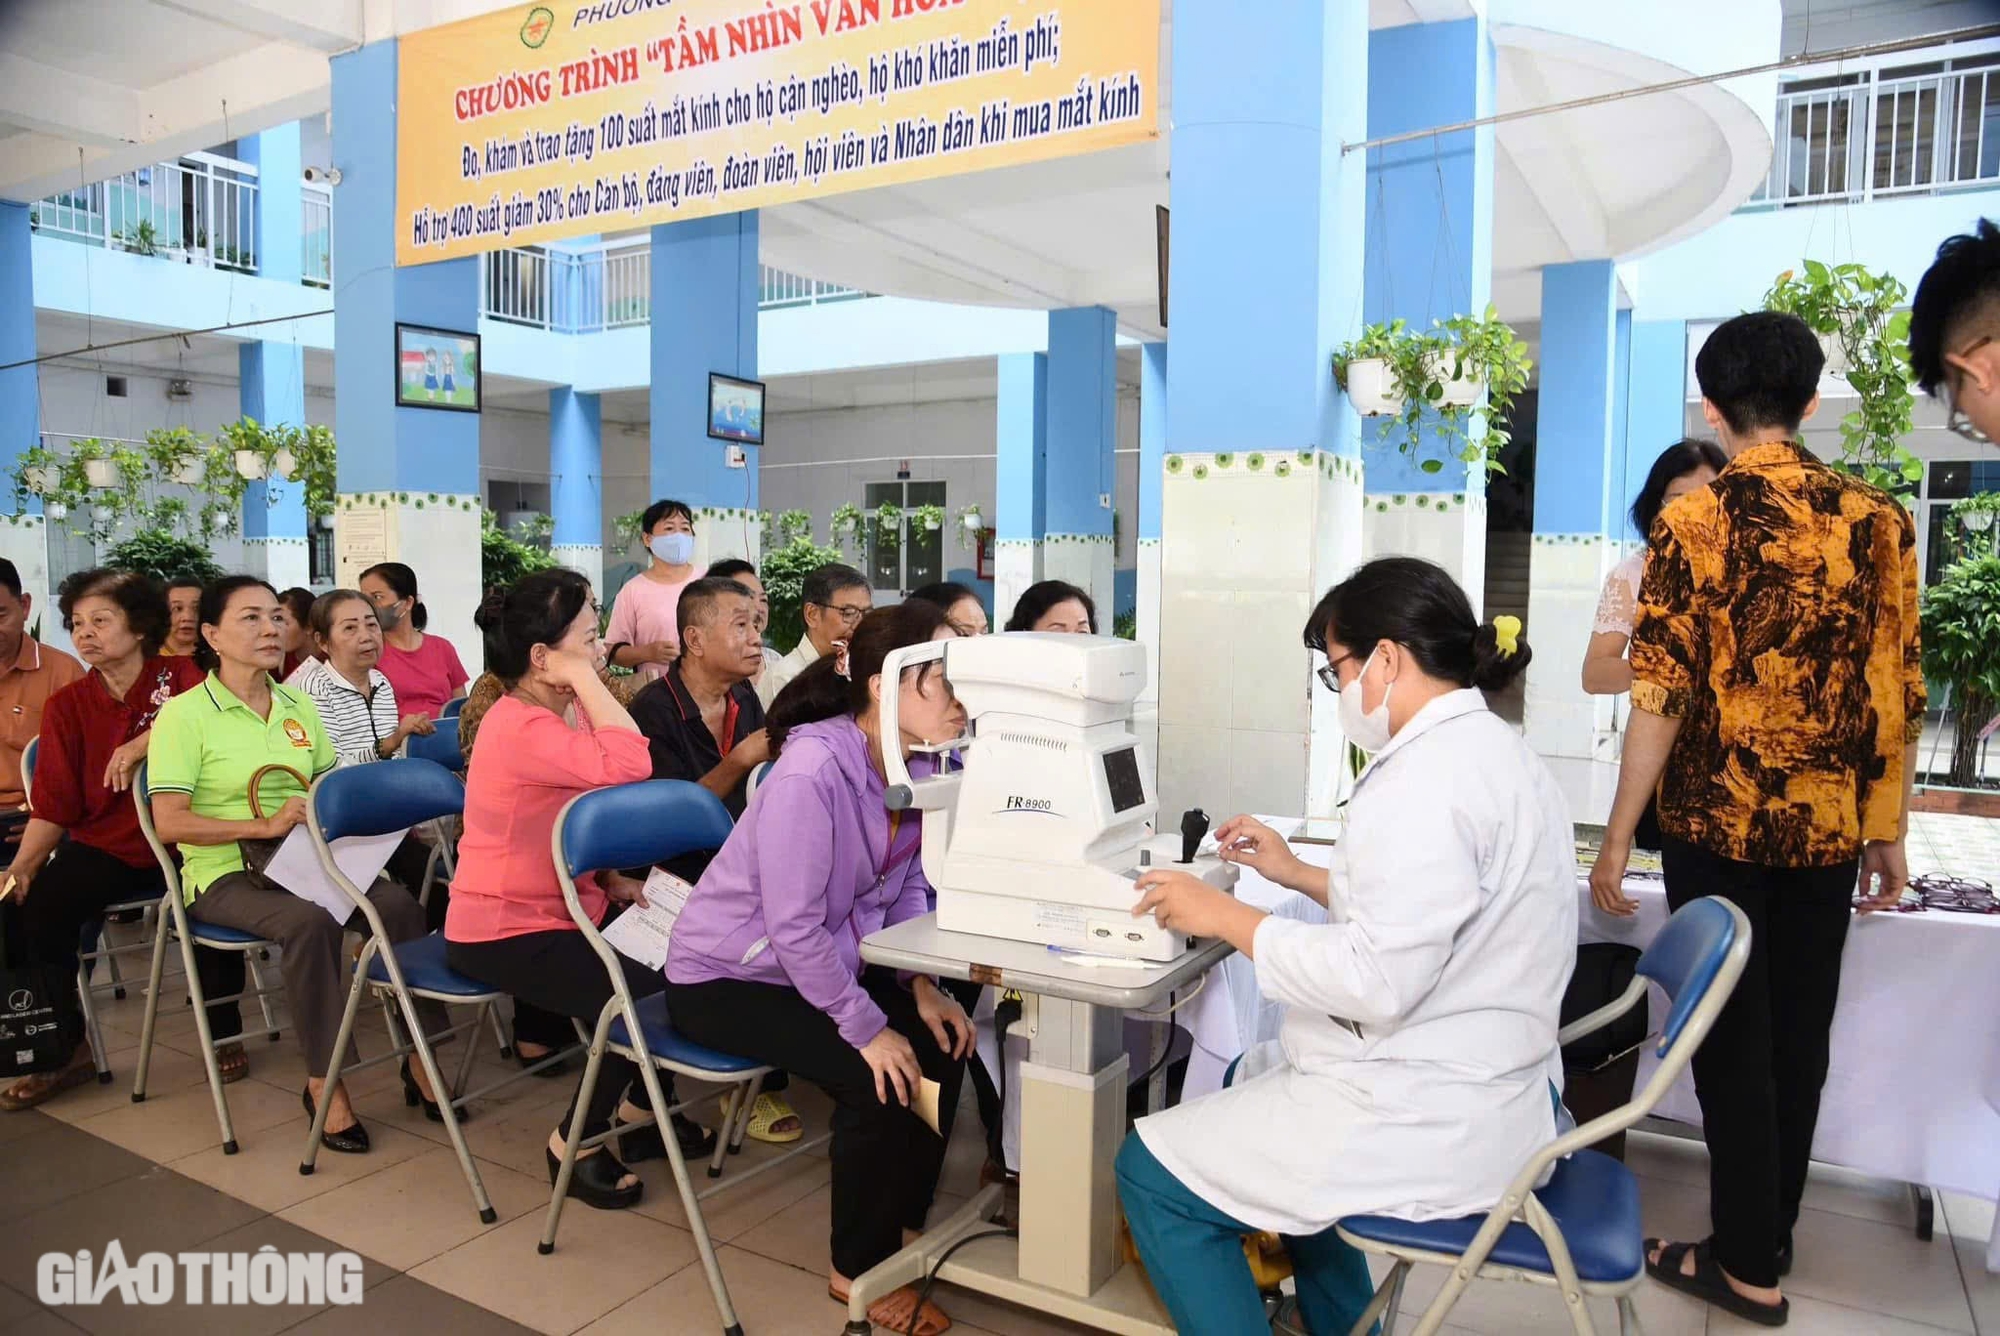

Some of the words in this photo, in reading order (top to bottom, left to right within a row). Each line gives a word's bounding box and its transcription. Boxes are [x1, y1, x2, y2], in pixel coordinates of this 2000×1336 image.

[455, 70, 551, 120] CHƯƠNG
[559, 47, 639, 96] TRÌNH
[724, 2, 802, 57] NHÌN
[519, 131, 535, 167] và
[535, 130, 562, 163] trao
[565, 123, 595, 164] tặng
[600, 113, 624, 150] 100
[628, 101, 656, 145] suất
[661, 94, 687, 140] mắt
[690, 92, 721, 134] kính
[725, 87, 751, 126] cho
[756, 79, 774, 126] hộ
[779, 74, 806, 121] cận
[812, 62, 863, 114] nghèo,
[869, 54, 888, 102] hộ
[894, 45, 923, 90] khó
[929, 36, 970, 82] khăn
[976, 20, 1018, 73] miễn
[1025, 14, 1058, 72] phí;
[414, 207, 430, 244] Hỗ
[450, 203, 474, 238] 400
[476, 195, 501, 235] suất
[537, 187, 565, 224] 30%
[568, 183, 591, 219] cho
[594, 178, 620, 214] Cán
[623, 171, 643, 216] bộ,
[645, 164, 681, 208] đảng
[684, 160, 718, 199] viên,
[723, 152, 759, 192] đoàn
[764, 144, 798, 186] viên,
[804, 136, 828, 184] hội
[833, 131, 866, 172] viên
[871, 125, 889, 165] và
[894, 117, 937, 161] Nhân
[942, 109, 974, 152] dân
[980, 101, 1008, 145] khi
[1012, 102, 1051, 140] mua
[1057, 77, 1093, 131] mắt
[1098, 74, 1140, 122] kính
